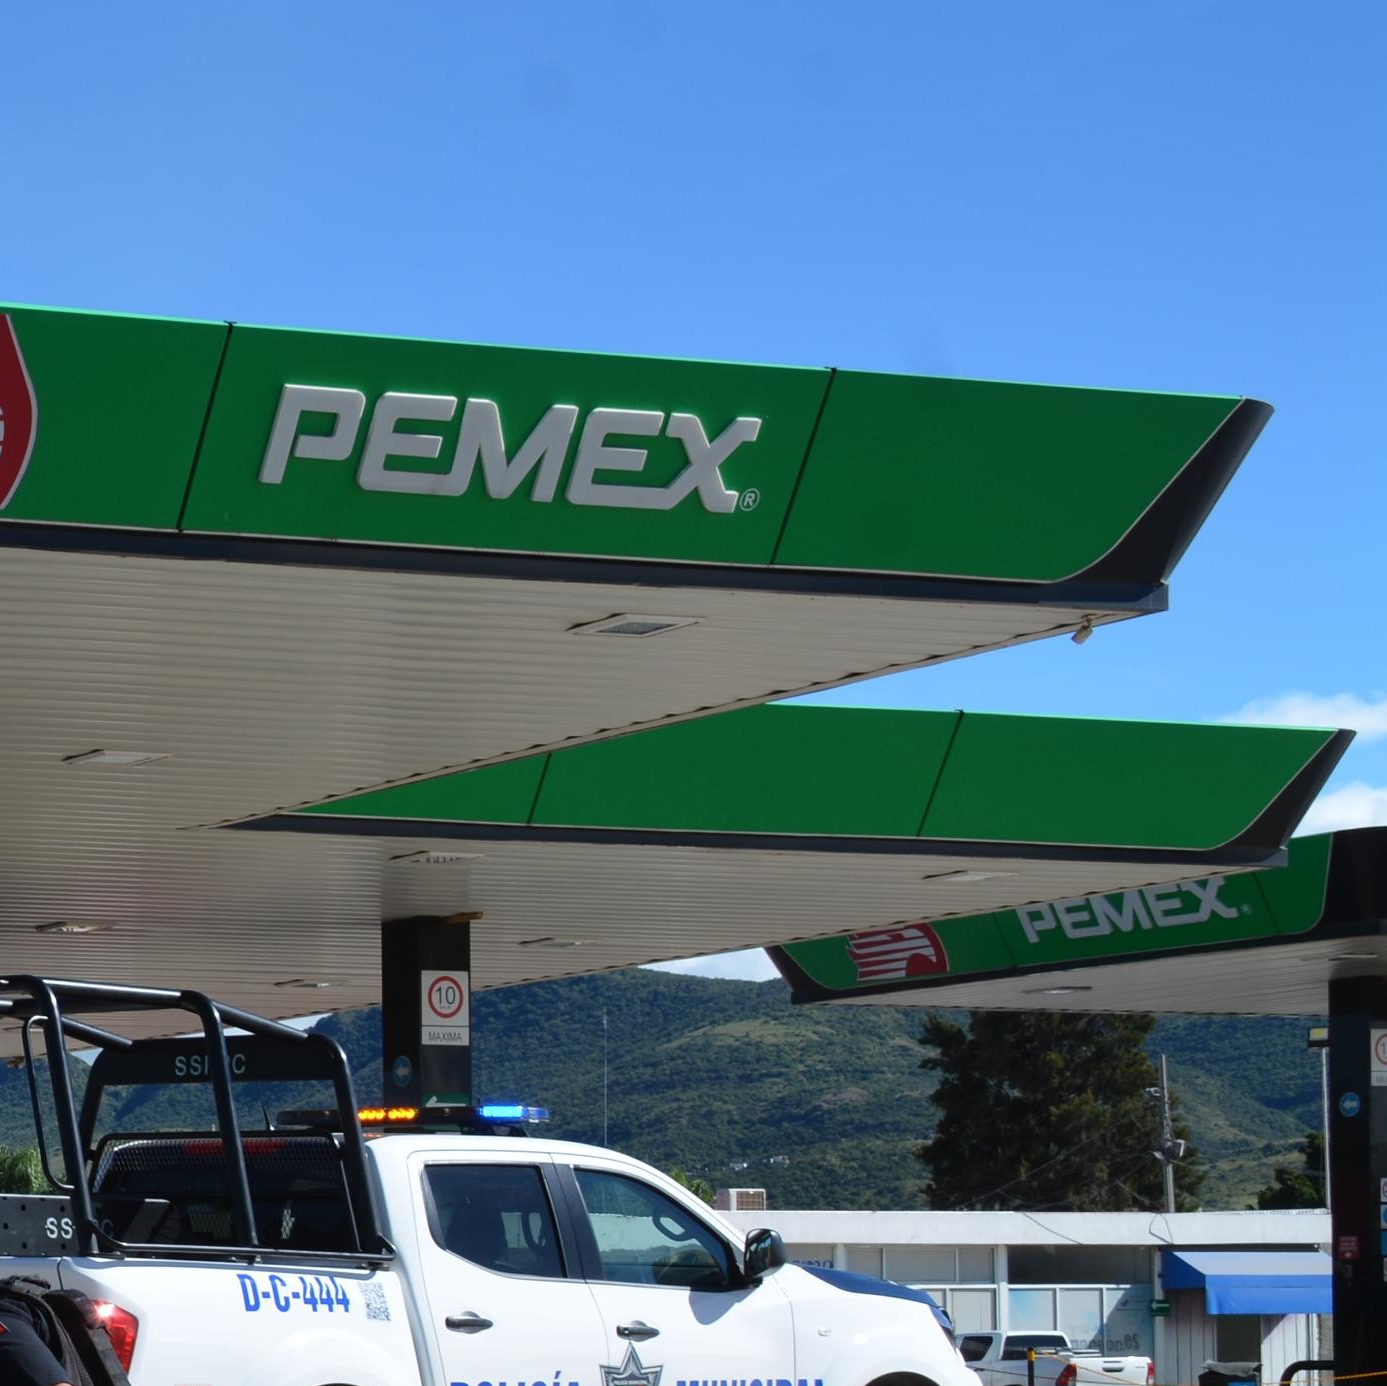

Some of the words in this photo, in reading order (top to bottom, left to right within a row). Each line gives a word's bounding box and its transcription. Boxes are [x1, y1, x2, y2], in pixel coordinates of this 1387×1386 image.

[259, 383, 762, 514] PEMEX
[1015, 877, 1239, 944] PEMEX
[435, 986, 456, 1005] 10
[428, 1031, 463, 1041] MAXIMA
[236, 1274, 350, 1313] D-C-444
